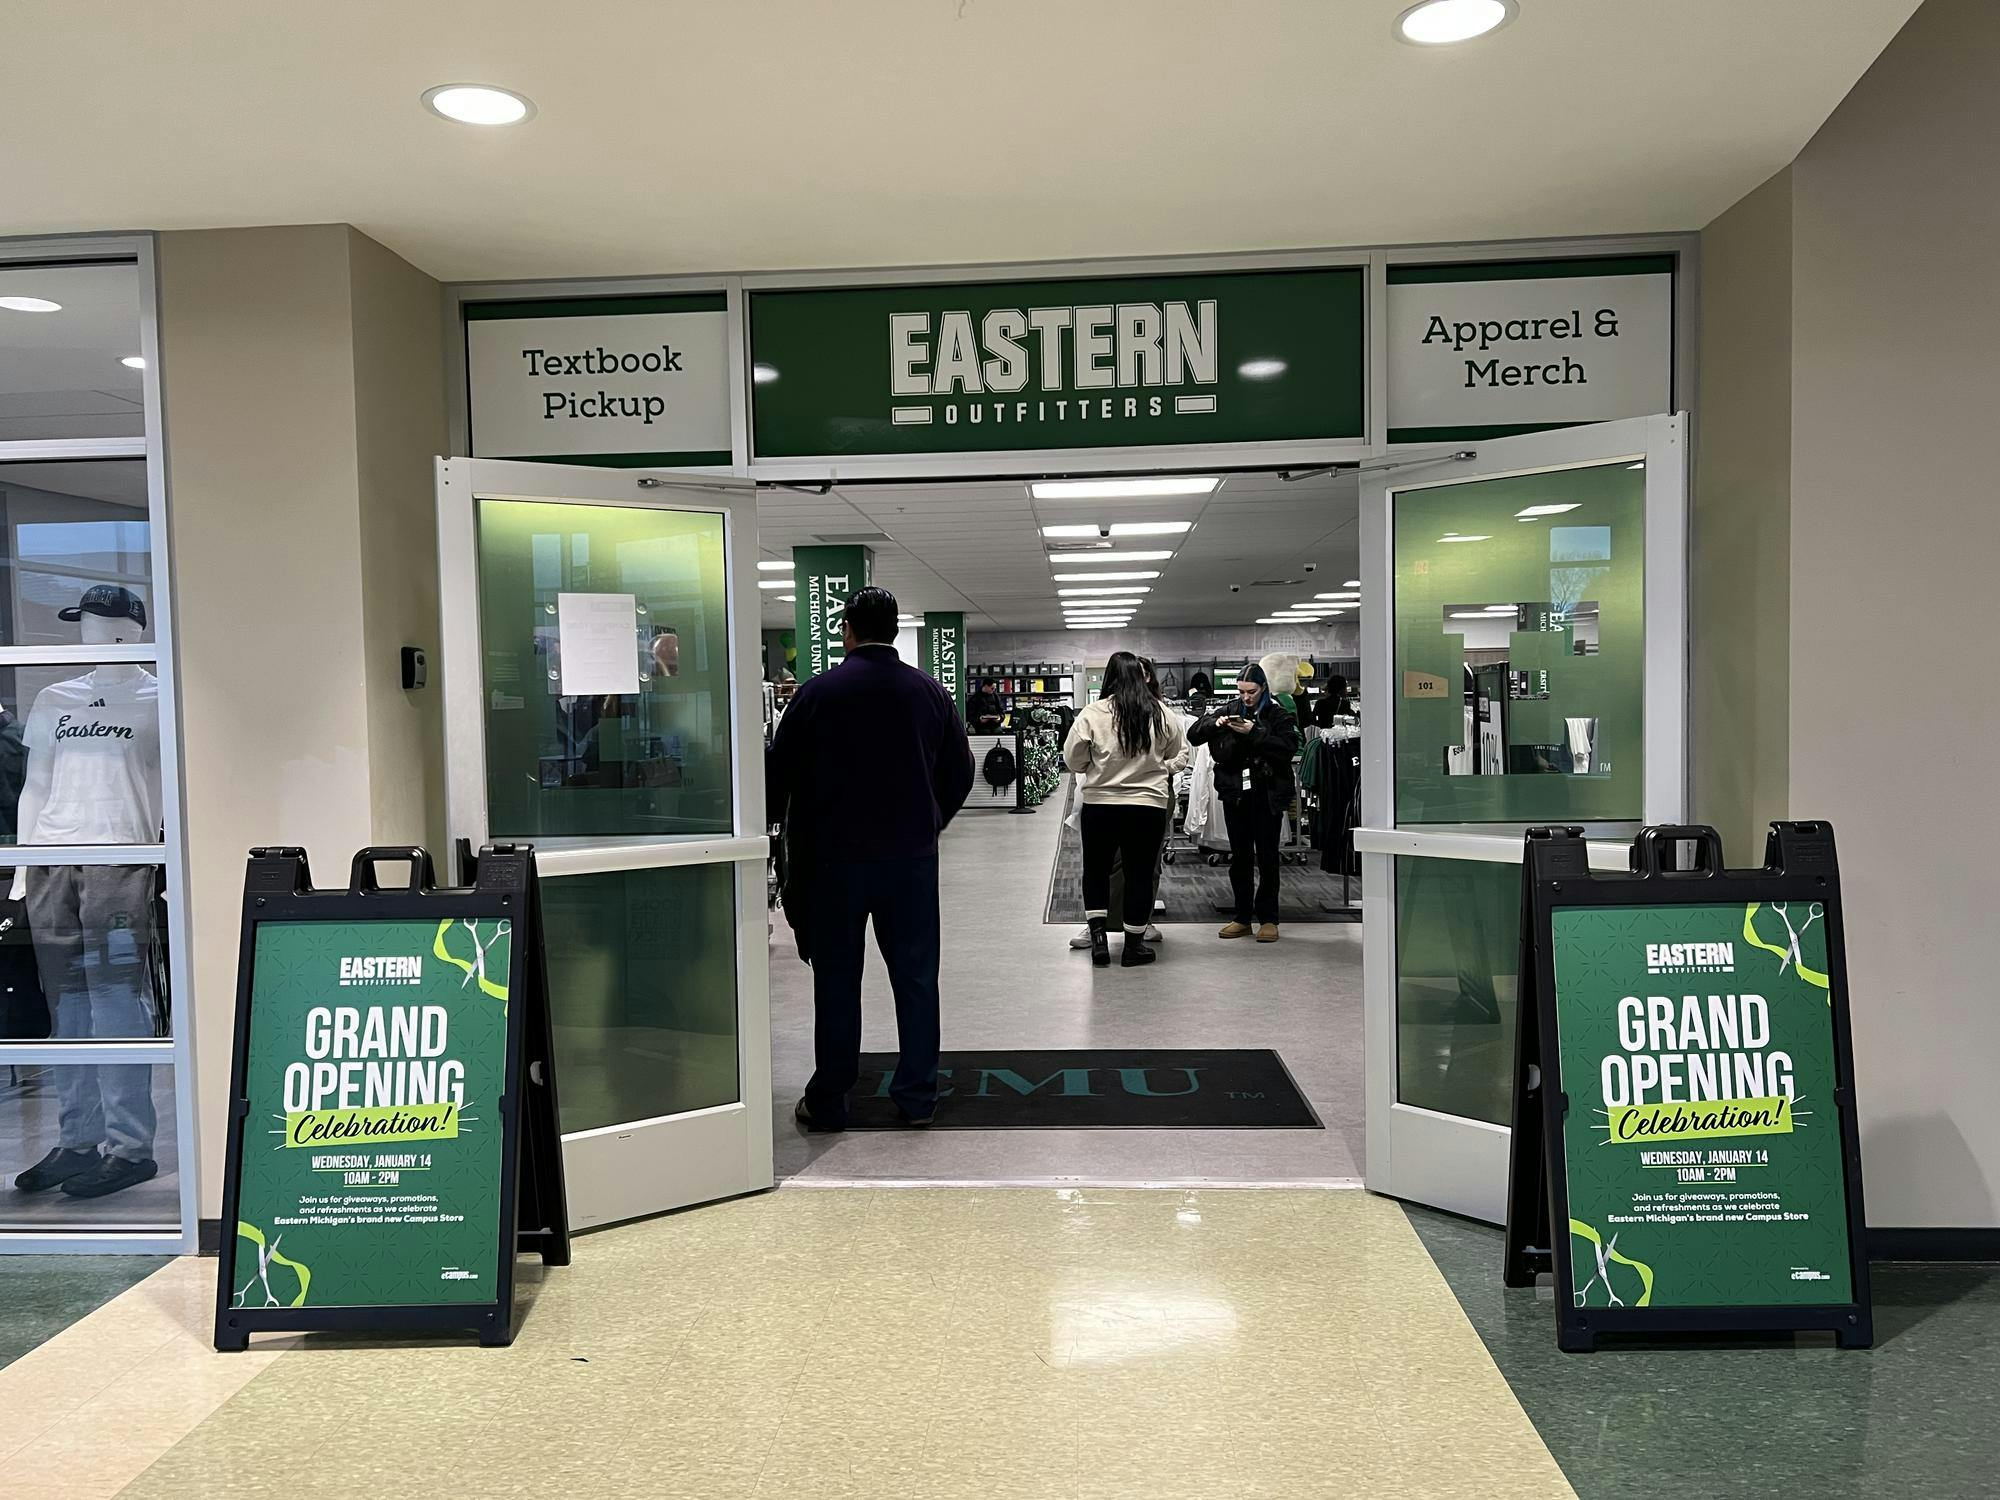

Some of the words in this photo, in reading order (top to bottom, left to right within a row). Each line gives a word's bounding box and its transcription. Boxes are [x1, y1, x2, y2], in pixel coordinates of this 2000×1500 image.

[1422, 310, 1582, 351] Apparel
[1594, 308, 1619, 338] &
[522, 345, 683, 376] Textbook
[889, 300, 1218, 397] EASTERN
[1464, 356, 1588, 388] Merch
[543, 389, 666, 424] Pickup
[945, 396, 1162, 425] OUTFITTERS
[809, 575, 821, 641] MICHIGAN
[811, 644, 822, 677] UNIV
[932, 628, 940, 664] MICHIGAN
[1418, 682, 1434, 690] 101
[55, 714, 134, 742] Eastern
[339, 956, 422, 979] EASTERN
[1646, 942, 1735, 966] EASTERN
[305, 1005, 448, 1060] GRAND
[1617, 994, 1770, 1052] GRAND
[283, 1060, 465, 1113] OPENING
[1600, 1051, 1795, 1108] OPENING
[294, 1105, 453, 1145] Celebration!
[1618, 1099, 1785, 1140] Celebration!
[311, 1155, 372, 1169] WEDNESDAY,
[374, 1155, 416, 1168] JANUARY
[420, 1154, 432, 1167] 14
[1640, 1151, 1706, 1165] WEDNESDAY,
[1707, 1151, 1753, 1164] JANUARY
[1756, 1150, 1769, 1163] 14
[343, 1171, 370, 1185] 10AM
[378, 1171, 399, 1184] 2PM
[1676, 1168, 1705, 1182] 10AM
[1714, 1167, 1736, 1181] 2PM
[299, 1196, 316, 1204] Join
[330, 1195, 343, 1203] for
[343, 1195, 389, 1205] giveaways,
[390, 1195, 439, 1204] promotions,
[299, 1206, 315, 1214] and
[317, 1205, 372, 1213] refreshments
[398, 1204, 438, 1212] celebrate
[1632, 1193, 1651, 1201] Join
[1665, 1193, 1678, 1201] for
[1679, 1192, 1728, 1203] giveaways,
[1729, 1192, 1781, 1202] promotions,
[1633, 1203, 1651, 1211] and
[1652, 1203, 1709, 1211] refreshments
[1739, 1202, 1780, 1210] celebrate
[274, 1217, 309, 1225] Eastern
[310, 1215, 355, 1226] Michigan's
[356, 1215, 384, 1224] brand
[404, 1215, 438, 1225] Campus
[440, 1214, 464, 1223] Store
[1608, 1215, 1645, 1223] Eastern
[1646, 1214, 1695, 1224] Michigan's
[1696, 1213, 1724, 1222] brand
[1745, 1213, 1783, 1223] Campus
[1784, 1212, 1809, 1221] Store
